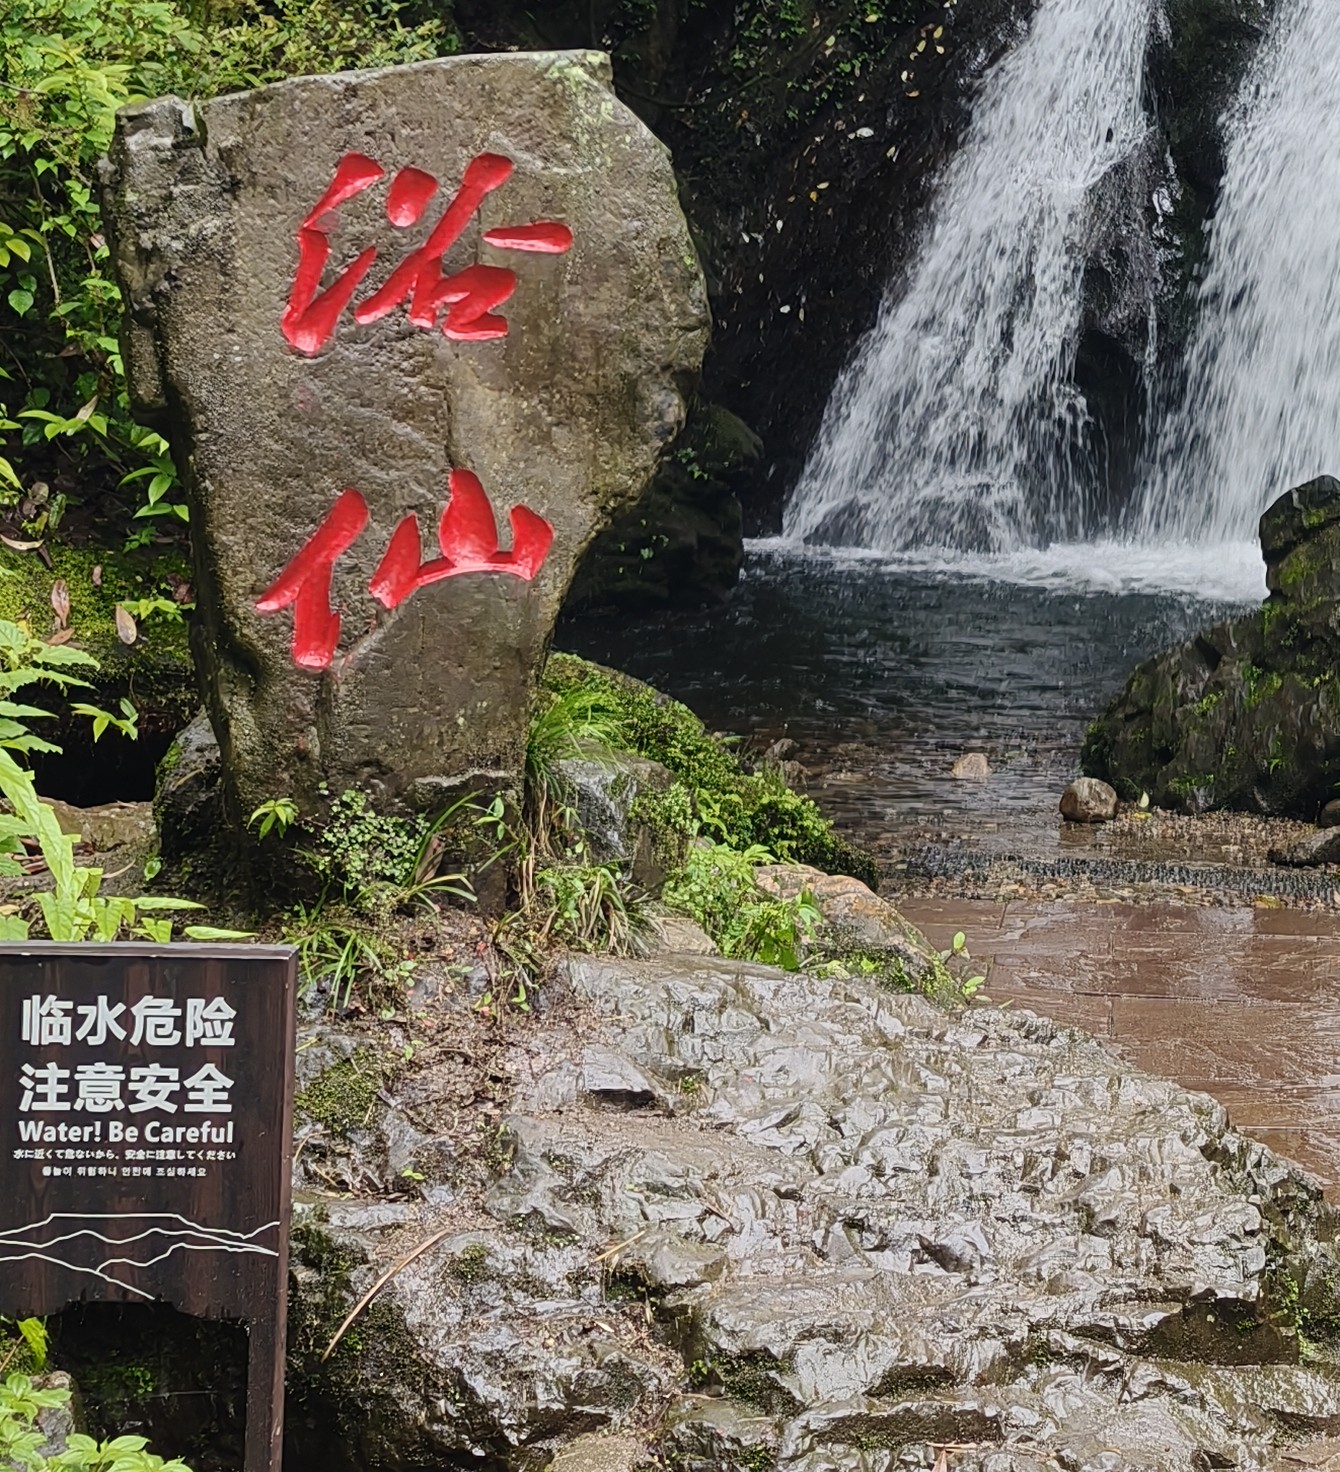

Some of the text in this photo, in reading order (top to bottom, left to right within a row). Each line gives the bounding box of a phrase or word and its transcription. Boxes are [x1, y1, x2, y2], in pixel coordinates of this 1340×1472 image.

[22, 995, 236, 1047] 临水危险
[19, 1062, 234, 1113] 注意安全
[19, 1121, 233, 1143] Water! Be Careful
